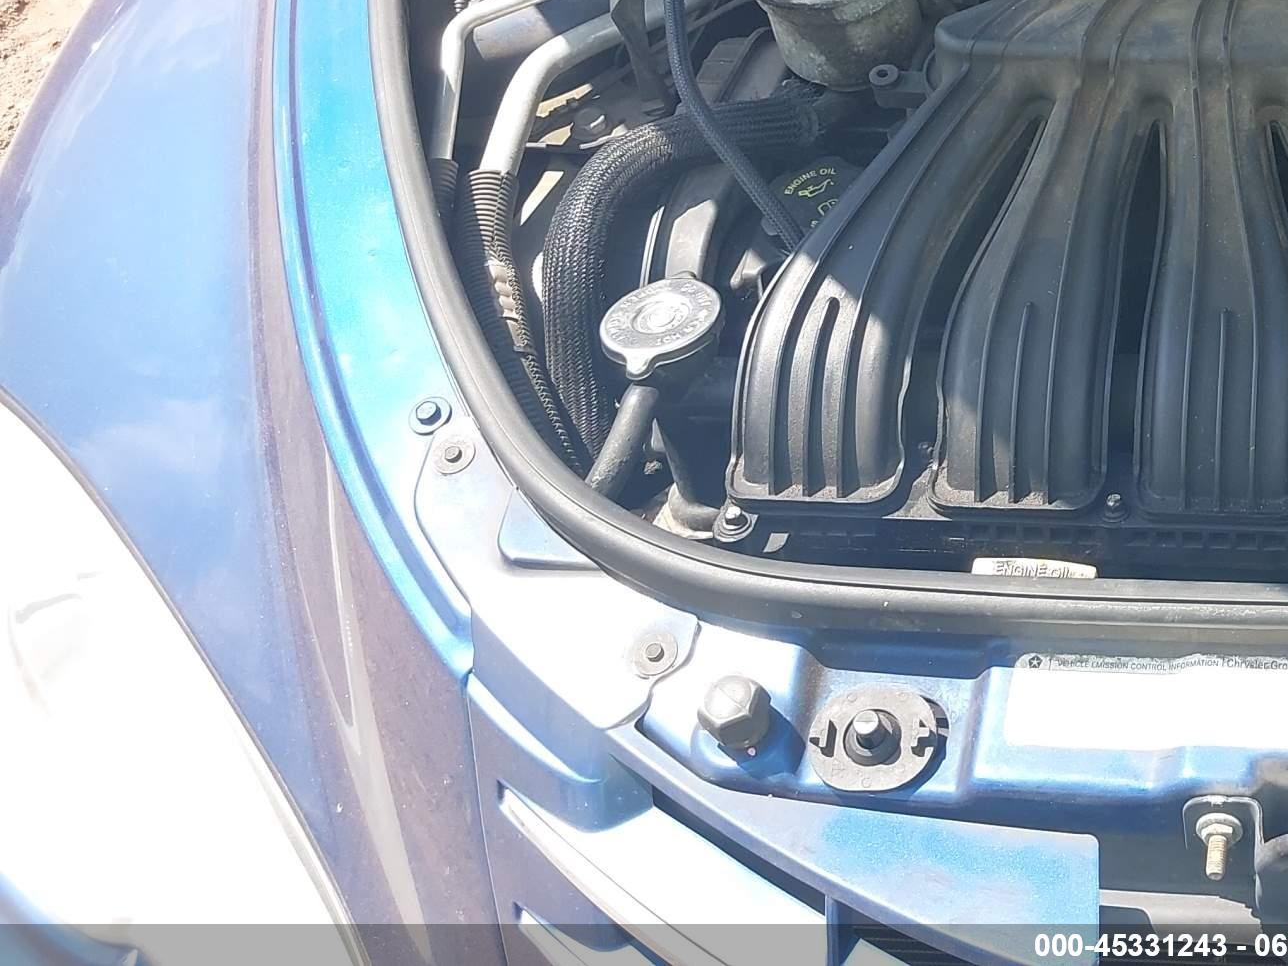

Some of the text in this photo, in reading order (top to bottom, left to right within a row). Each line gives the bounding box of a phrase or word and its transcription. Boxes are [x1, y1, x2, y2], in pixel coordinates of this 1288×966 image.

[783, 167, 837, 195] ENGINE OIL
[1057, 657, 1219, 672] VEHICLE EMISSION CONTROL INFORMATION
[1226, 658, 1269, 670] Chrysler
